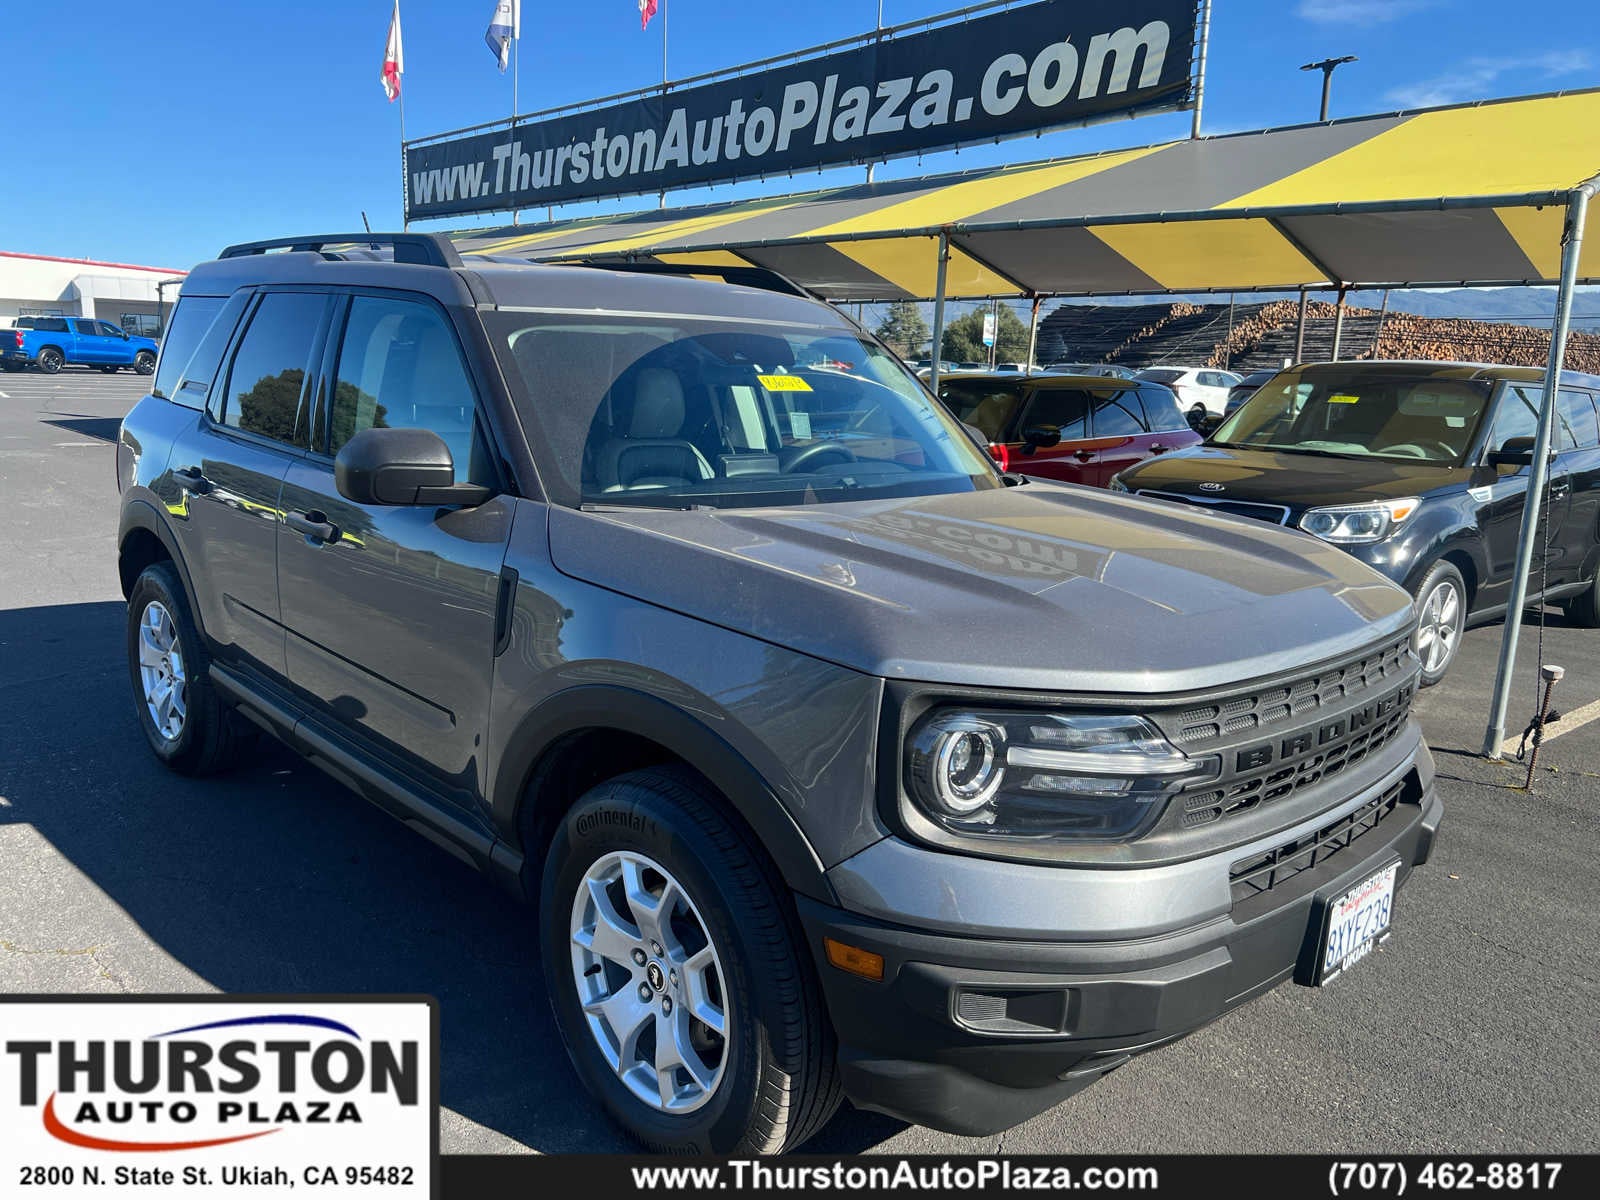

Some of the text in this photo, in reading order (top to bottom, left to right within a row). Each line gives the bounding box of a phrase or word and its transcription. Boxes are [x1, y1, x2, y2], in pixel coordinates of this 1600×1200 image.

[412, 20, 1170, 205] www.ThurstonAutoPlaza.com
[576, 807, 646, 836] Continental
[1325, 893, 1390, 968] 8XYF238
